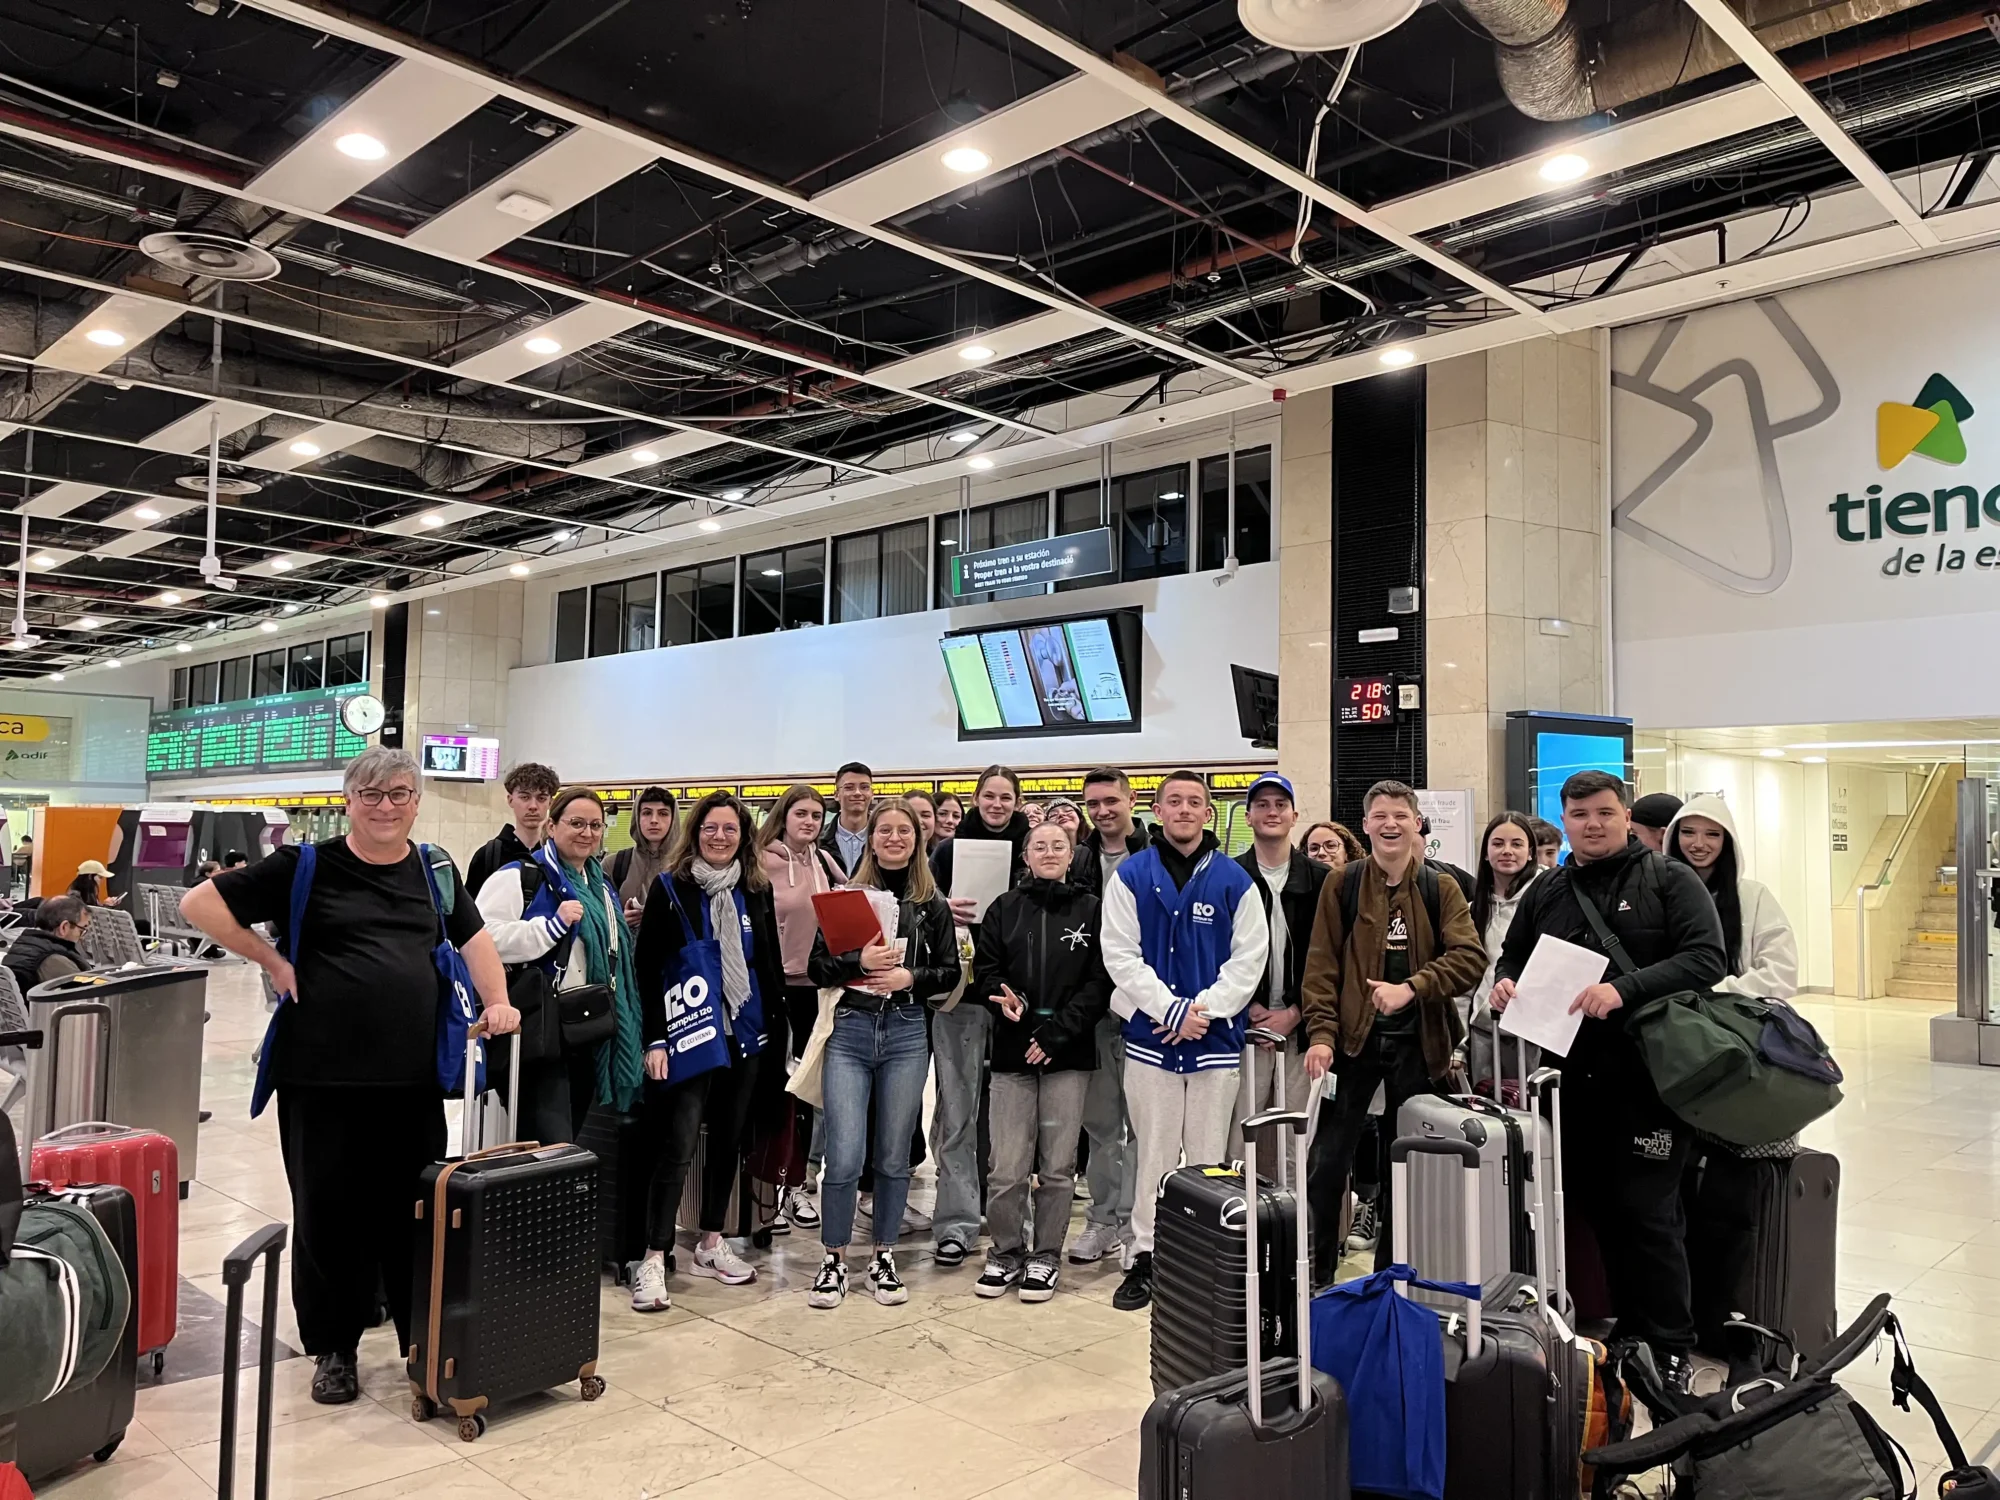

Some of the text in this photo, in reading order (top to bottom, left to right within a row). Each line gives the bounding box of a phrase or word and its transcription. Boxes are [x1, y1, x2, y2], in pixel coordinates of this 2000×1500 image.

[973, 559, 996, 570] Próximo
[997, 557, 1010, 565] tren
[1024, 548, 1050, 561] estación
[1882, 547, 1925, 575] de
[1936, 543, 1965, 572] la
[973, 570, 994, 580] Proper
[994, 568, 1007, 577] tren
[1013, 564, 1020, 573] la
[1020, 562, 1040, 572] vostra
[1041, 554, 1074, 569] destinació
[21, 751, 48, 760] adif
[667, 1011, 699, 1031] campus
[699, 1006, 713, 1016] 120
[687, 1030, 712, 1045] CCI VIENNE
[1634, 1136, 1672, 1149] NORTH
[1651, 1131, 1672, 1141] THE
[1644, 1146, 1670, 1156] FACE
